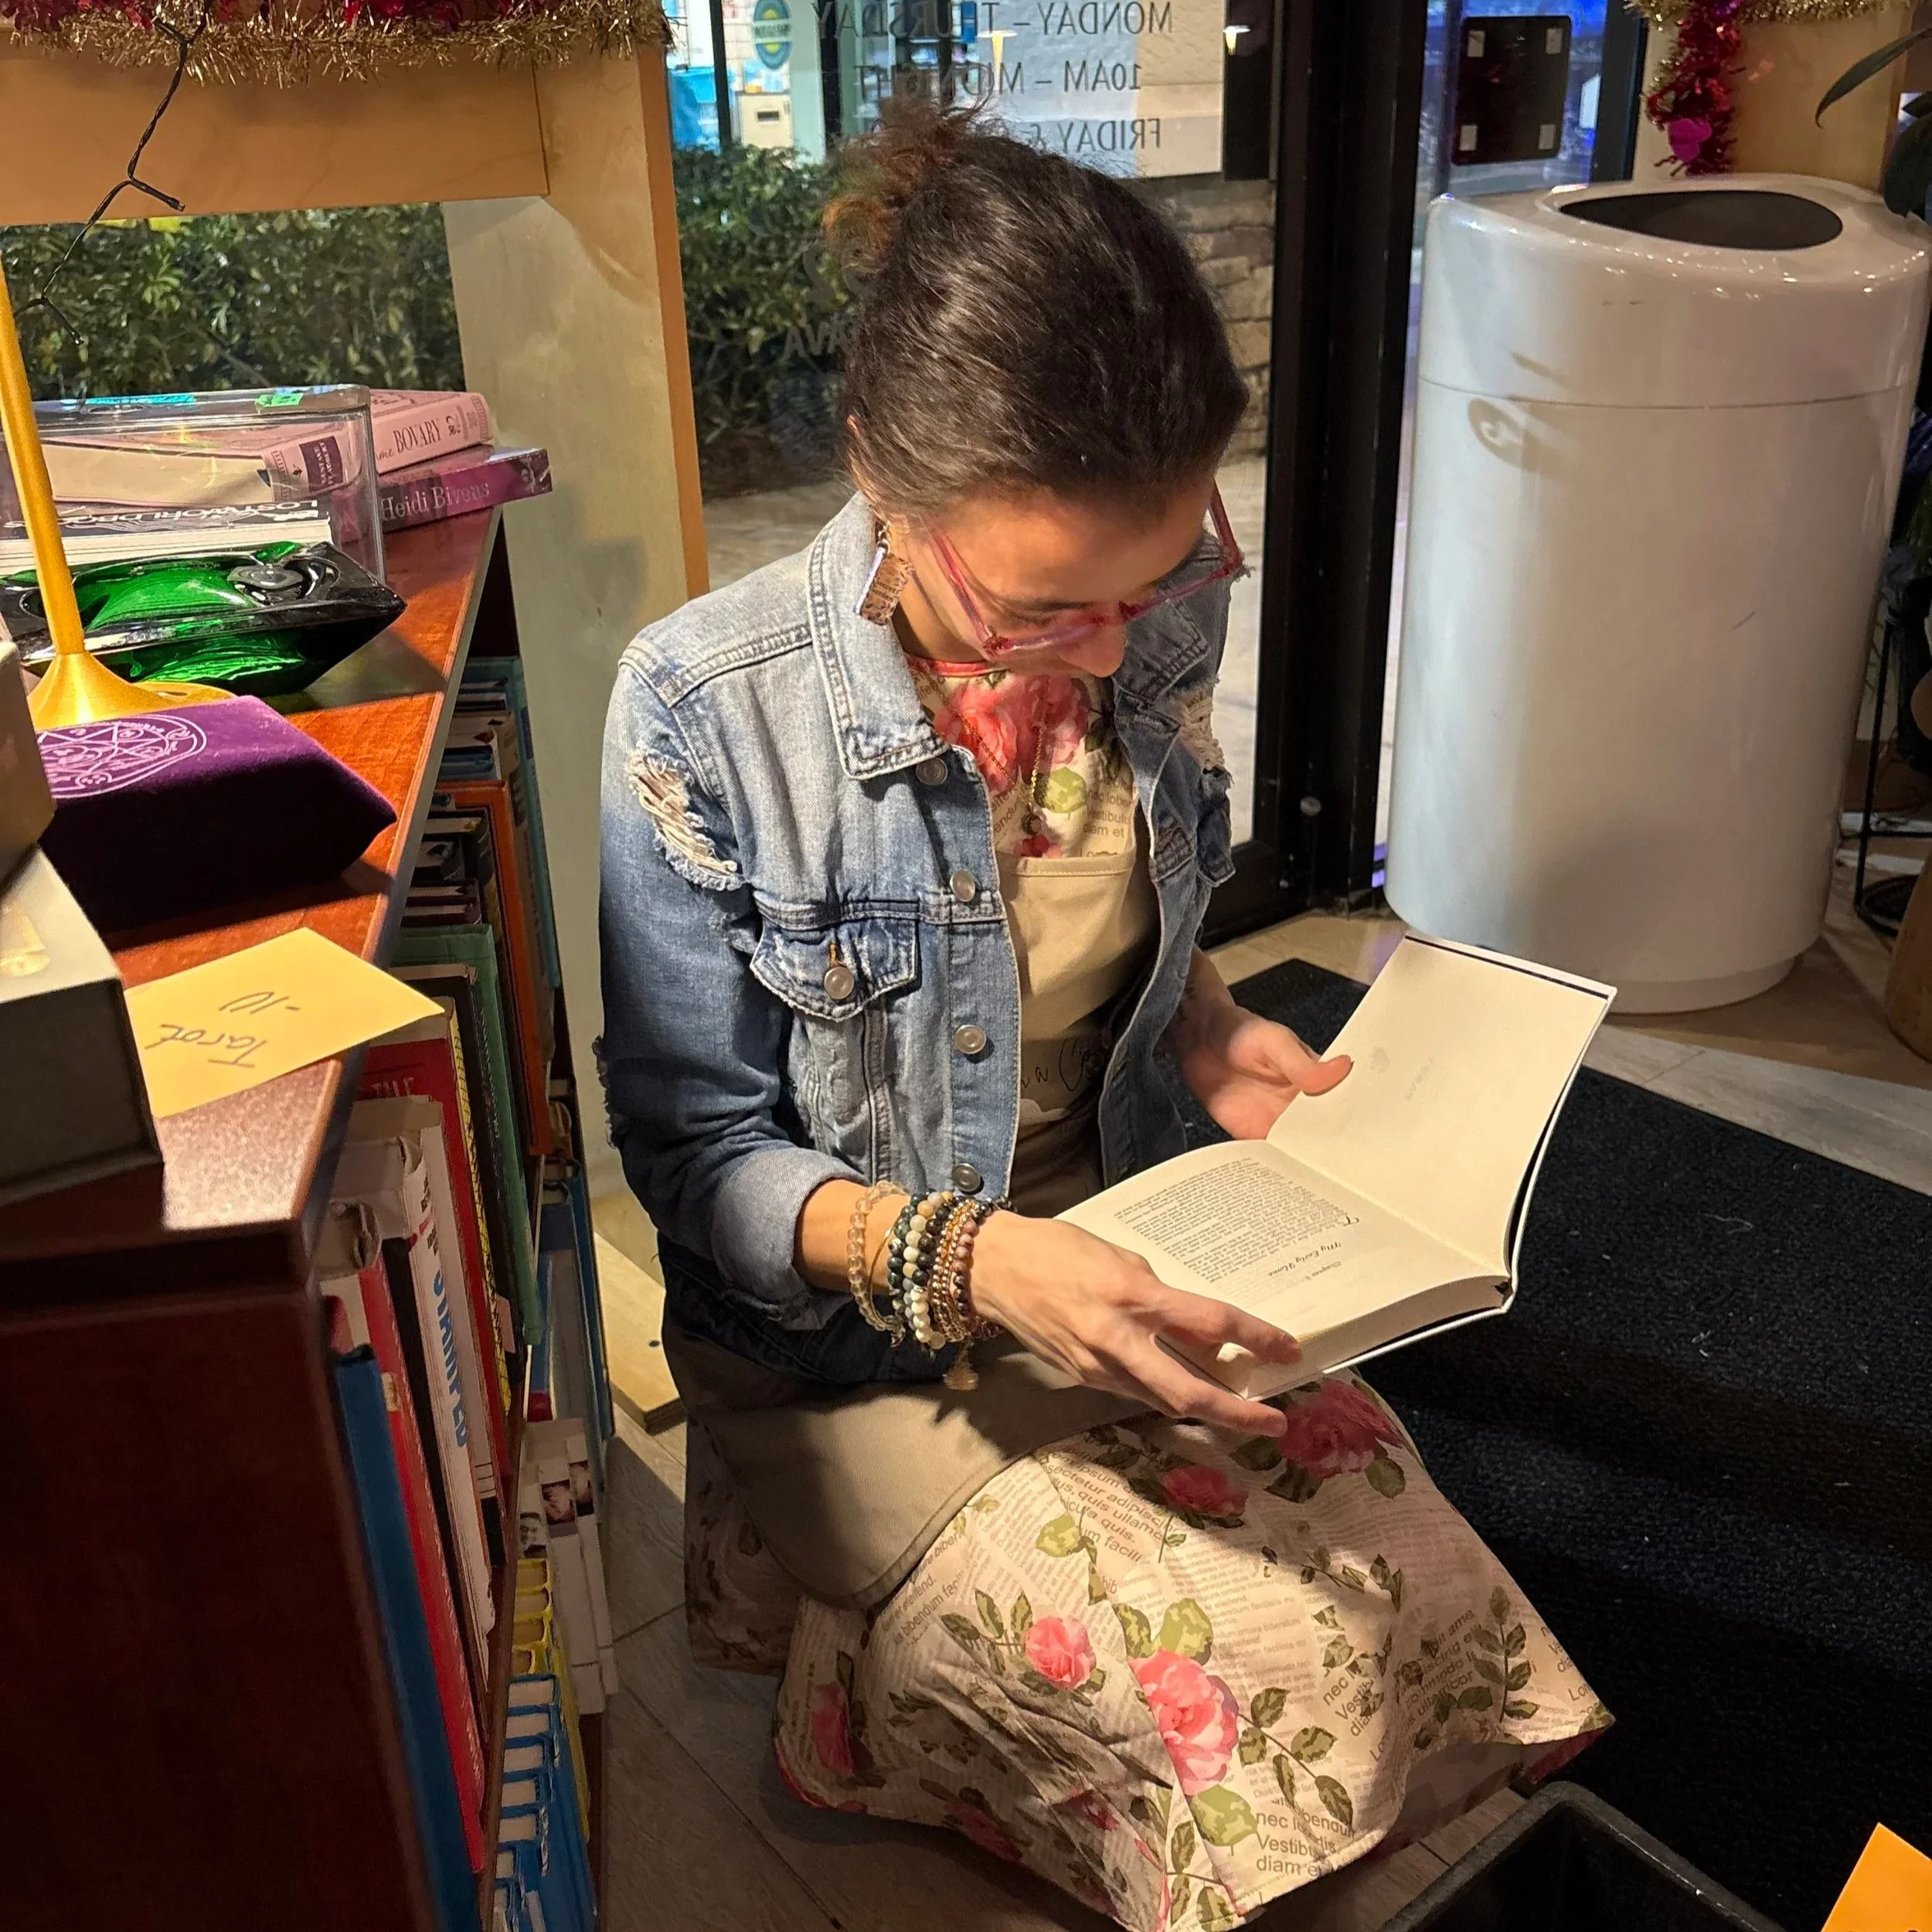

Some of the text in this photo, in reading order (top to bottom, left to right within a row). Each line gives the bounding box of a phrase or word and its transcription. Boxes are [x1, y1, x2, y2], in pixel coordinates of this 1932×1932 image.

[393, 417, 442, 454] BOVARY
[381, 488, 429, 521] Heidi
[1112, 827, 1125, 838] et
[144, 1023, 267, 1068] Tarot
[1077, 1464, 1121, 1489] ipsum
[1077, 1489, 1110, 1512] quis
[1100, 1518, 1135, 1543] quis.
[900, 1592, 945, 1638] bibendum
[1322, 1676, 1349, 1707] nec
[1256, 1811, 1289, 1831] nec
[1256, 1855, 1301, 1876] diam
